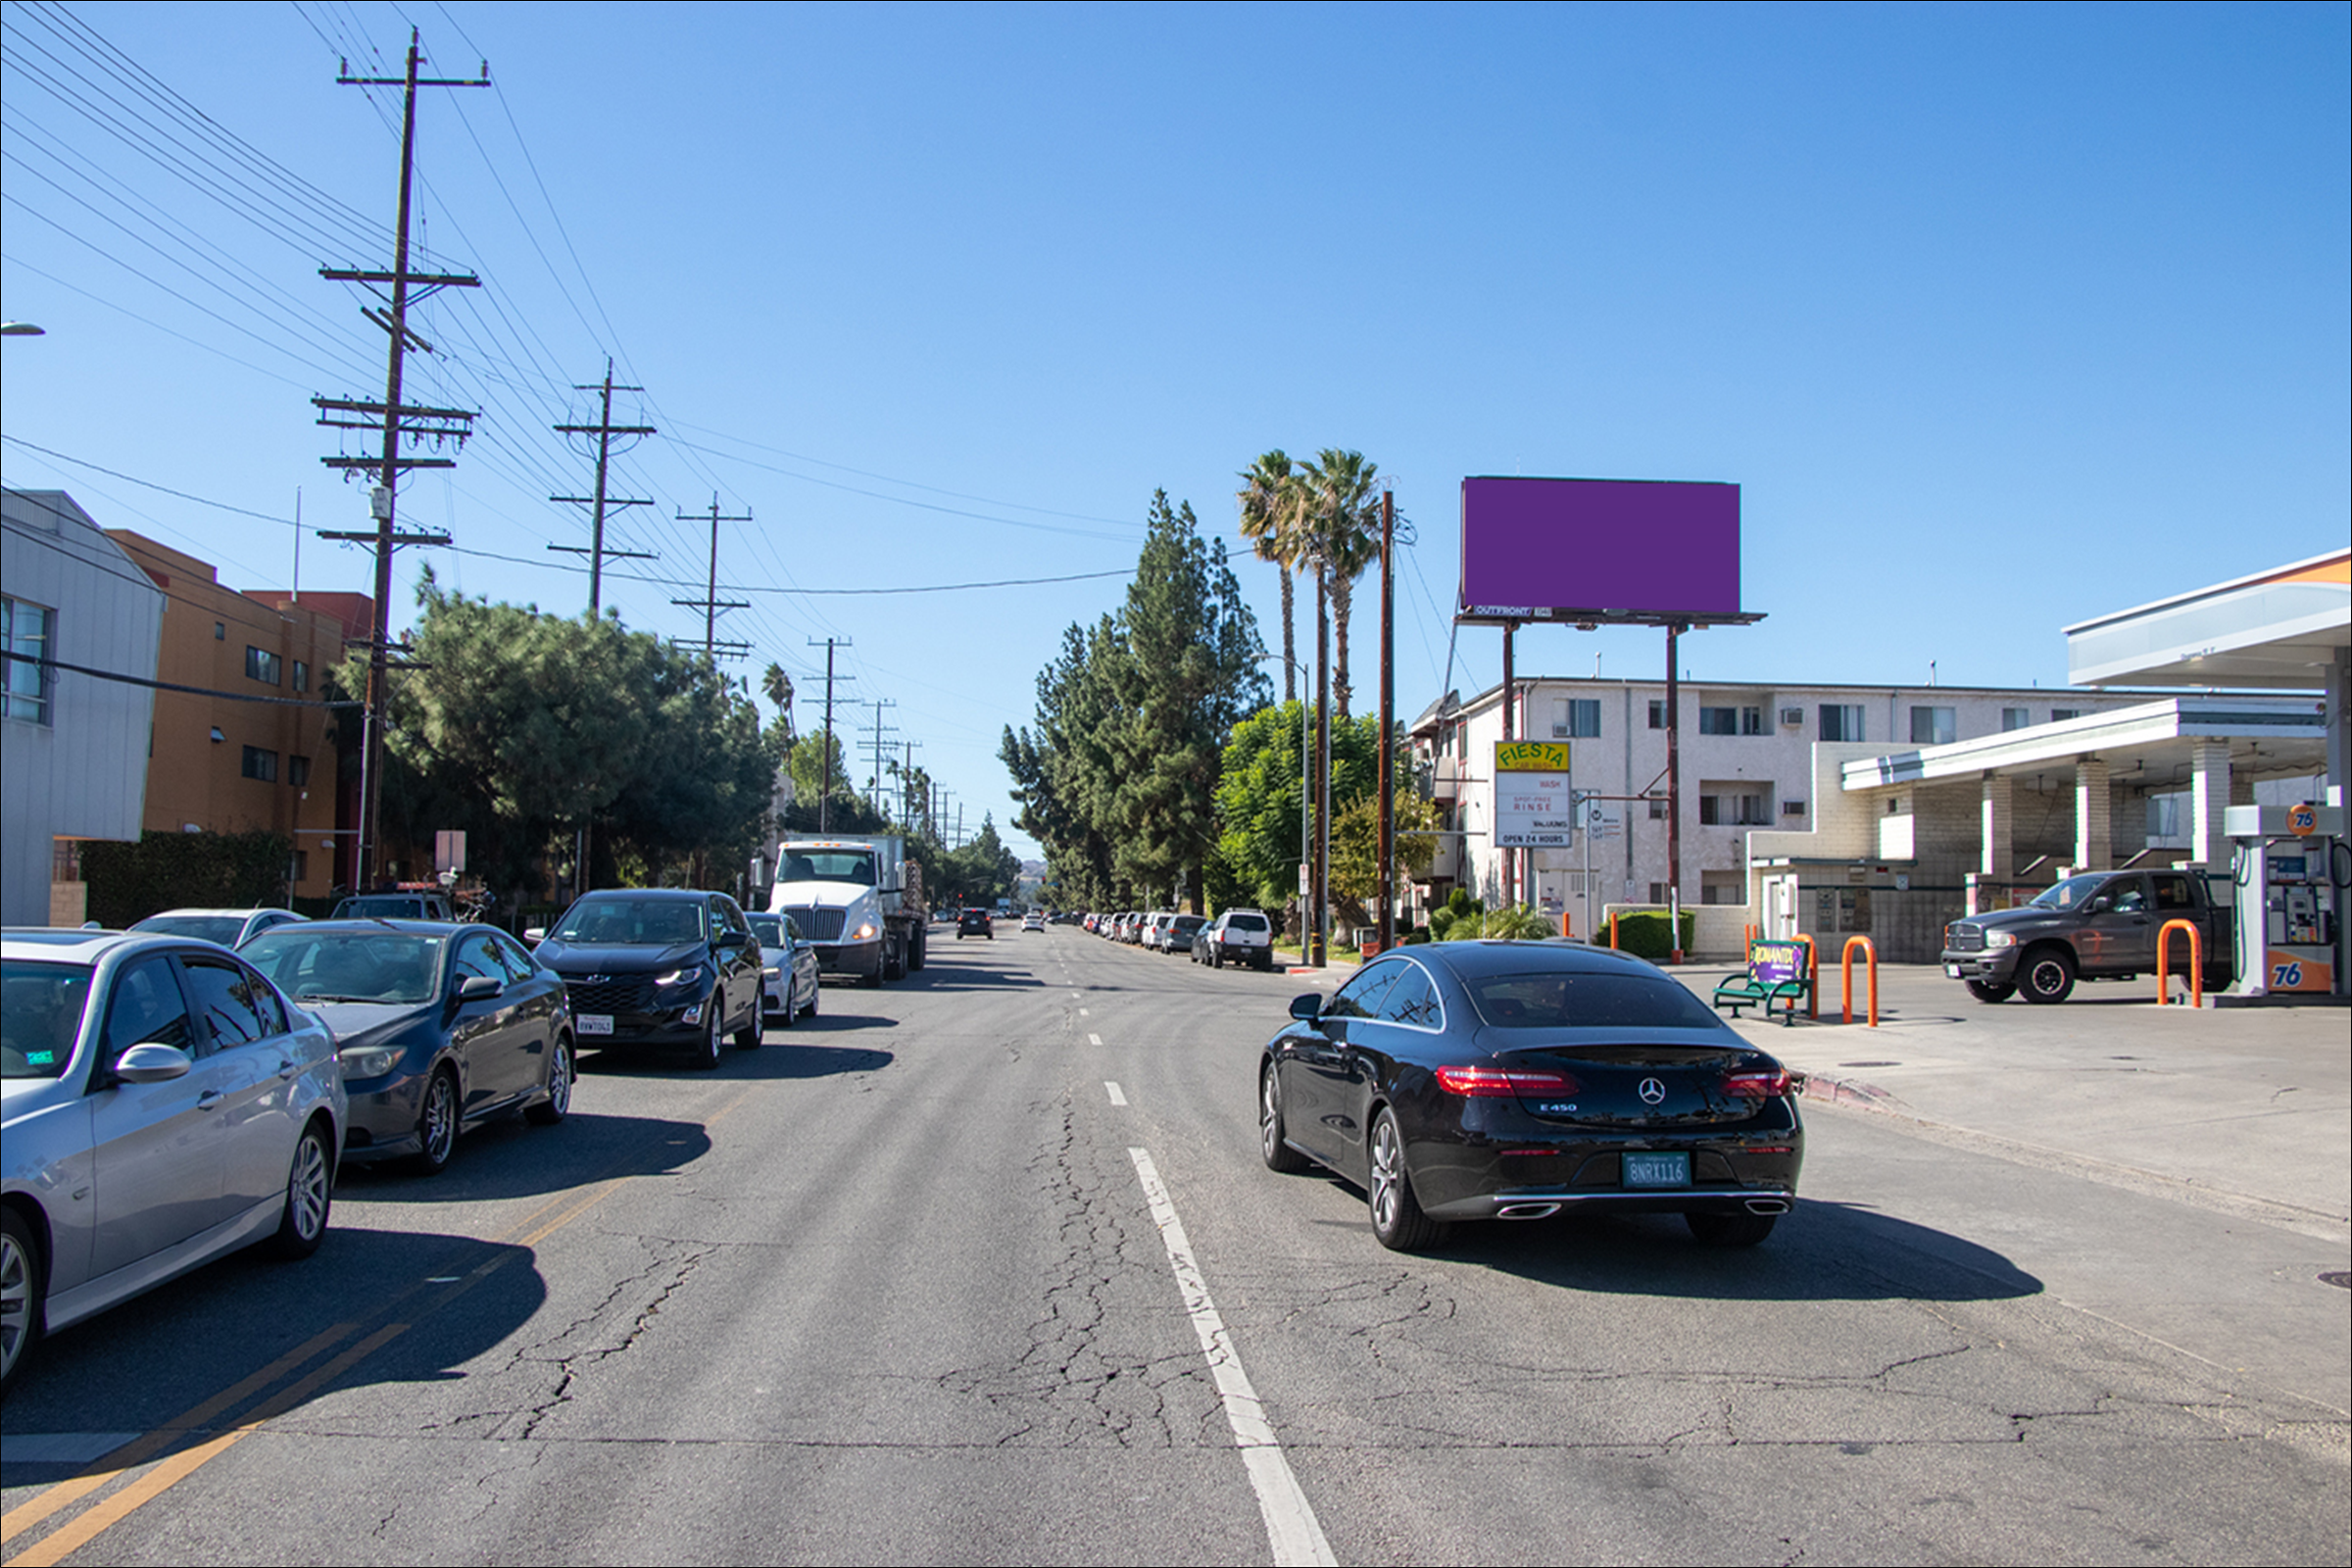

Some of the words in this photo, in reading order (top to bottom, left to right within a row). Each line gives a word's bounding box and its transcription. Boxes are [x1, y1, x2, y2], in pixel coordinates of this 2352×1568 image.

[1475, 605, 1531, 616] OUTFRONT
[1499, 742, 1564, 766] FIESTA
[1539, 780, 1561, 789] WASH
[2294, 812, 2314, 827] 76
[1502, 834, 1523, 843] OPEN
[1525, 834, 1537, 843] 24
[1539, 834, 1564, 843] HOURS
[2272, 961, 2303, 987] 76
